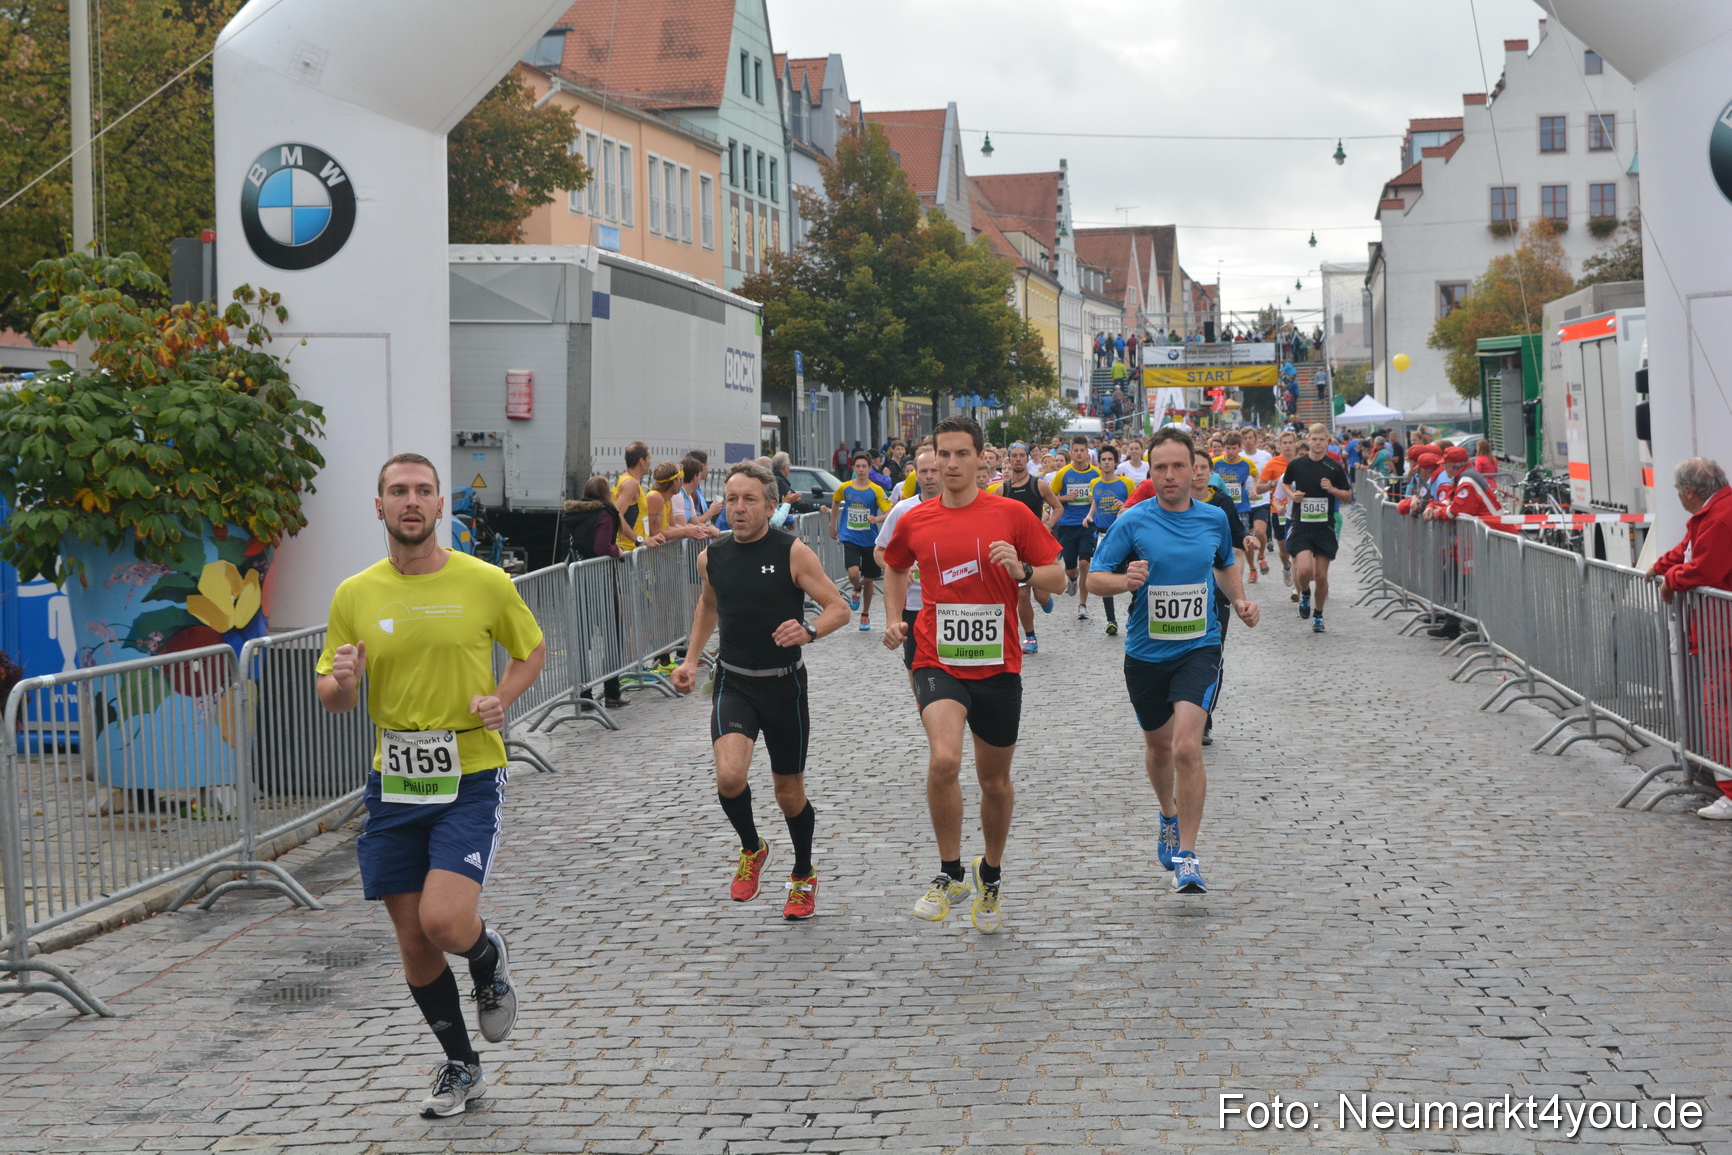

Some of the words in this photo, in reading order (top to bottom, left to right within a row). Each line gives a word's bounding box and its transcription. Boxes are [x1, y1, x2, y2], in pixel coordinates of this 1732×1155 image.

[247, 145, 347, 188] BMW
[725, 347, 756, 393] BOCK
[1187, 370, 1233, 382] START
[1303, 503, 1326, 513] 5045
[849, 513, 868, 523] 5518
[951, 566, 969, 578] DEHN
[1171, 589, 1200, 597] Neumarkt
[938, 609, 960, 617] PARTL
[960, 609, 993, 617] Neumarkt
[1155, 597, 1203, 619] 5078
[943, 619, 998, 642] 5085
[1162, 623, 1196, 633] Clemens
[954, 648, 985, 660] Jürgen
[388, 744, 453, 774] 5159
[403, 780, 439, 796] Philipp
